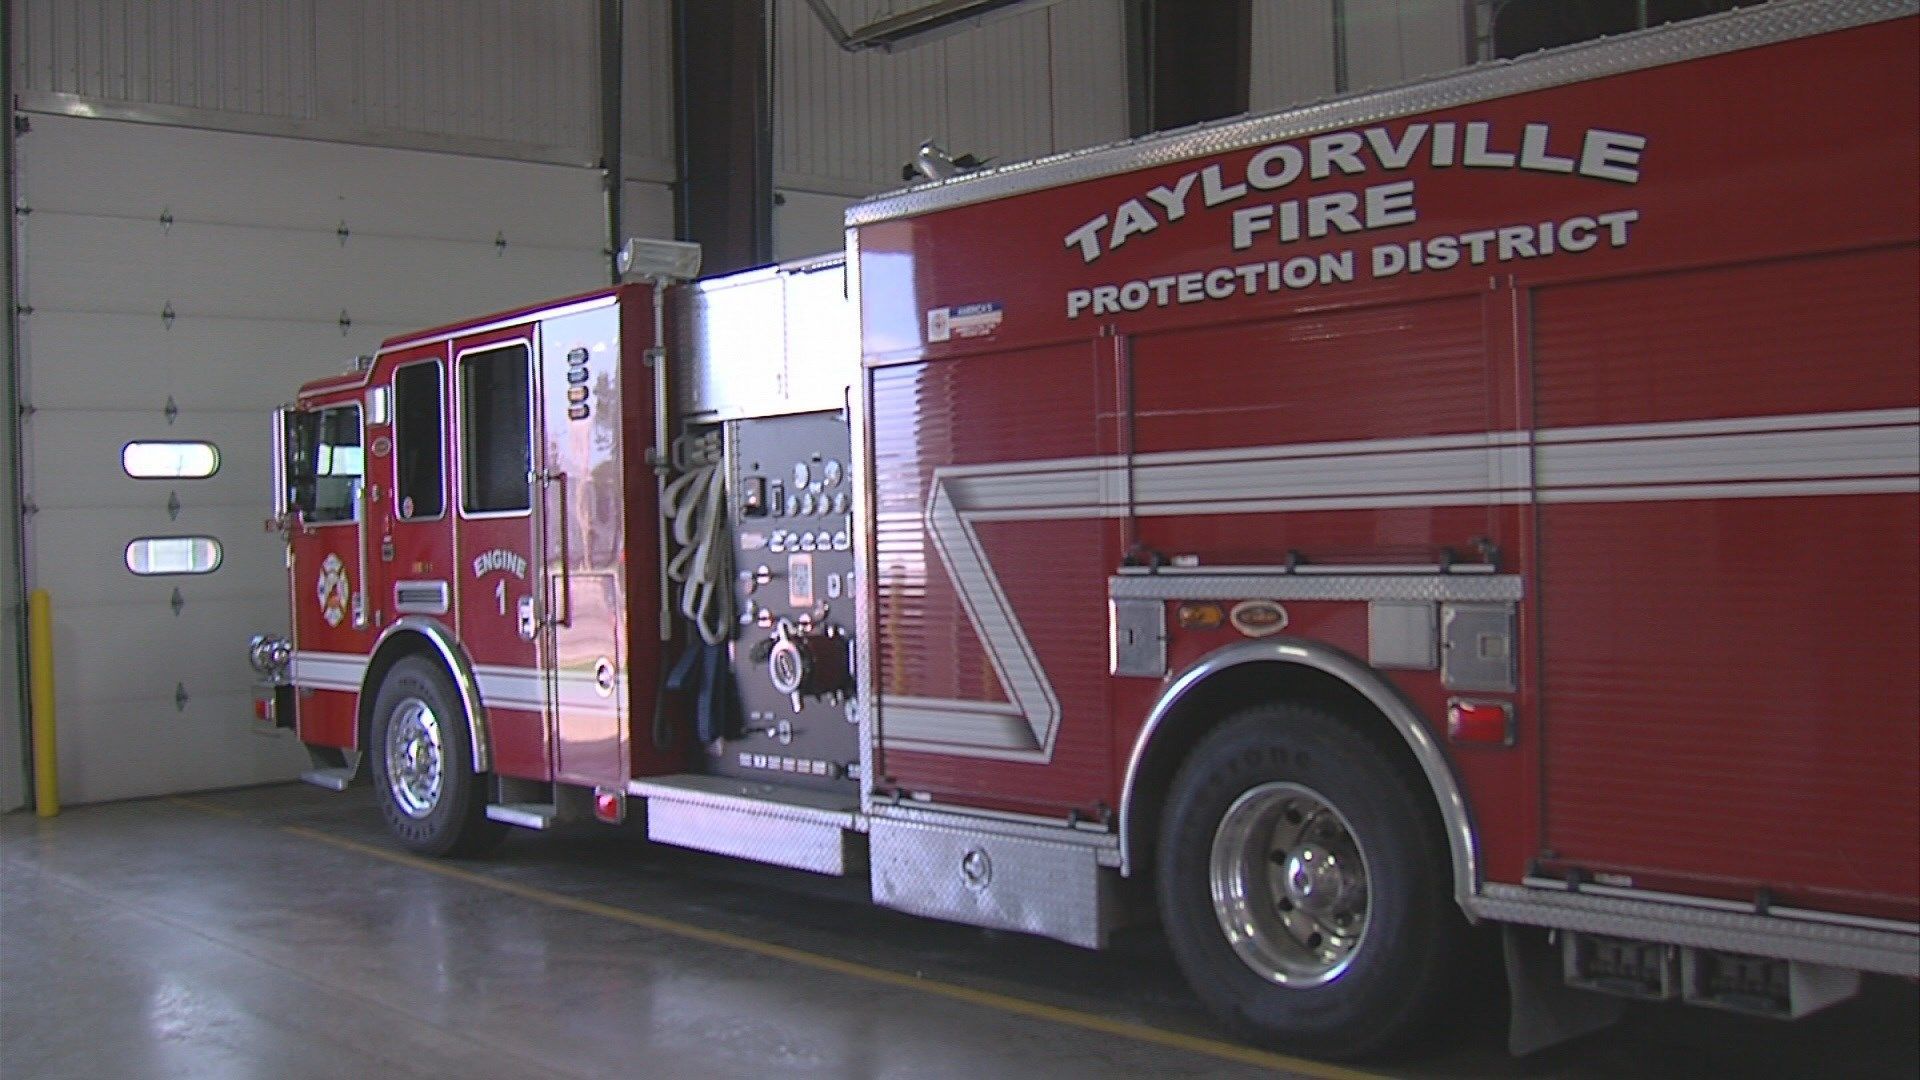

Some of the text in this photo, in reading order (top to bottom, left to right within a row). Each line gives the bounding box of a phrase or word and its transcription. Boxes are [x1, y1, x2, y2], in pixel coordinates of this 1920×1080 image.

[1064, 122, 1647, 263] TAYLORVILLE
[1232, 181, 1416, 250] FIRE
[1066, 210, 1639, 318] PROTECTION DISTRICT
[473, 548, 527, 578] ENGINE
[496, 579, 506, 615] 1
